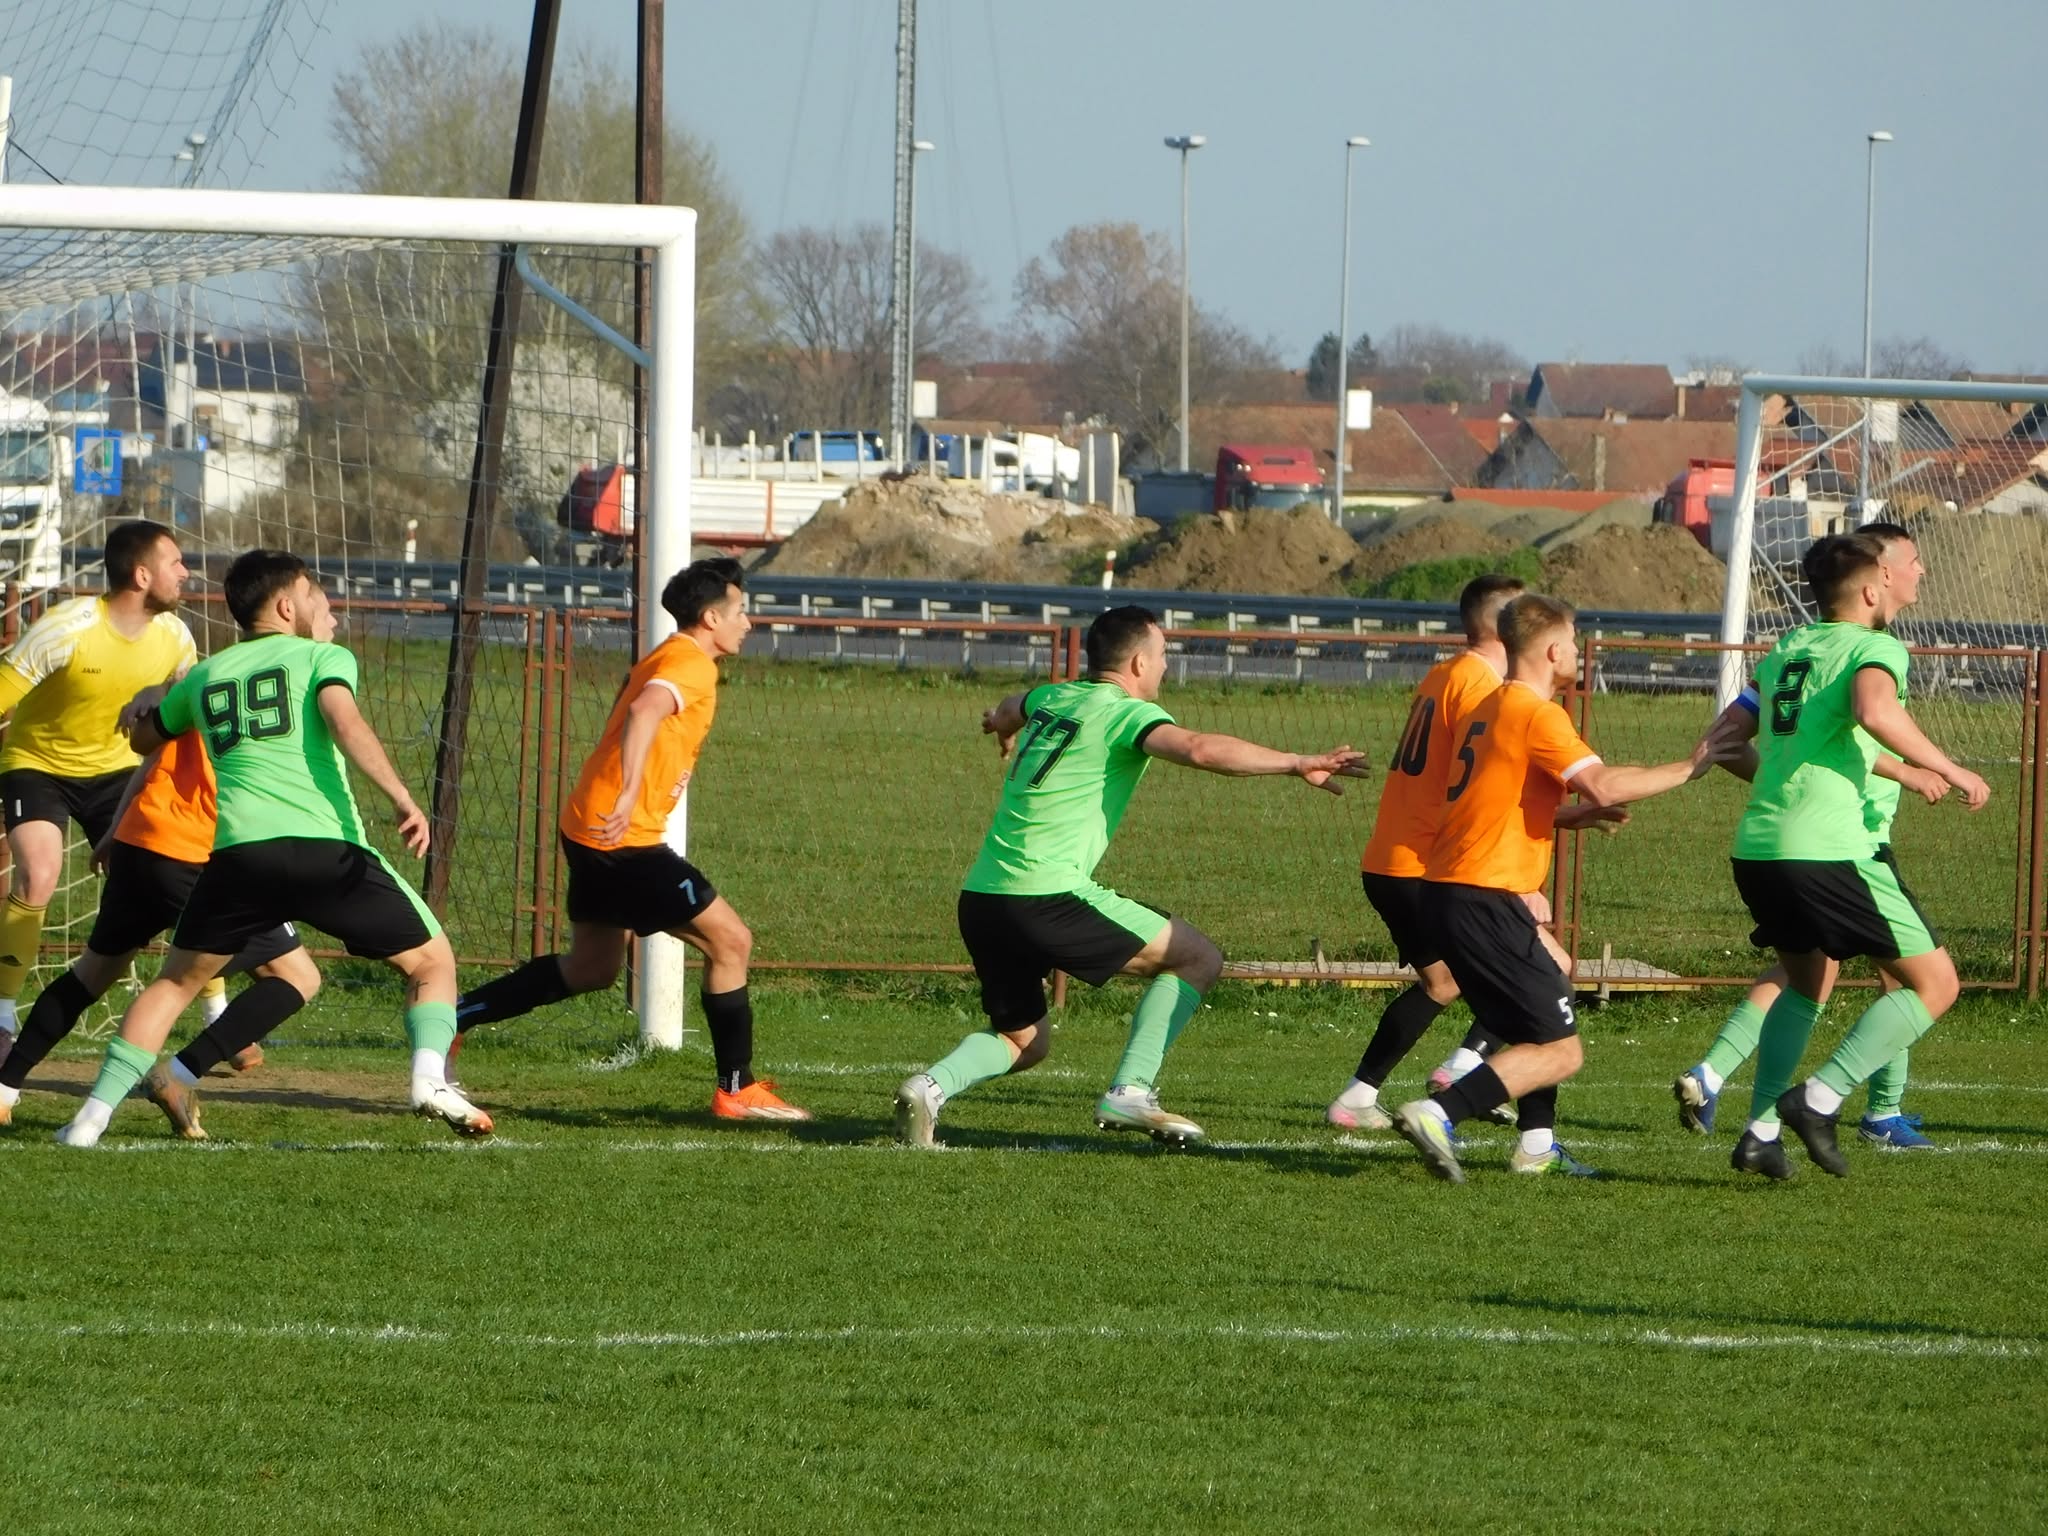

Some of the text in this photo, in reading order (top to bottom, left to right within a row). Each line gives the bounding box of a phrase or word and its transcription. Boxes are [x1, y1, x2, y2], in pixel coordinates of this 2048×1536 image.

[202, 664, 295, 759] 99
[1771, 657, 1811, 736] 2
[1008, 706, 1084, 789] 77
[1446, 722, 1487, 802] 5
[677, 878, 697, 905] 7
[1558, 996, 1574, 1025] 5
